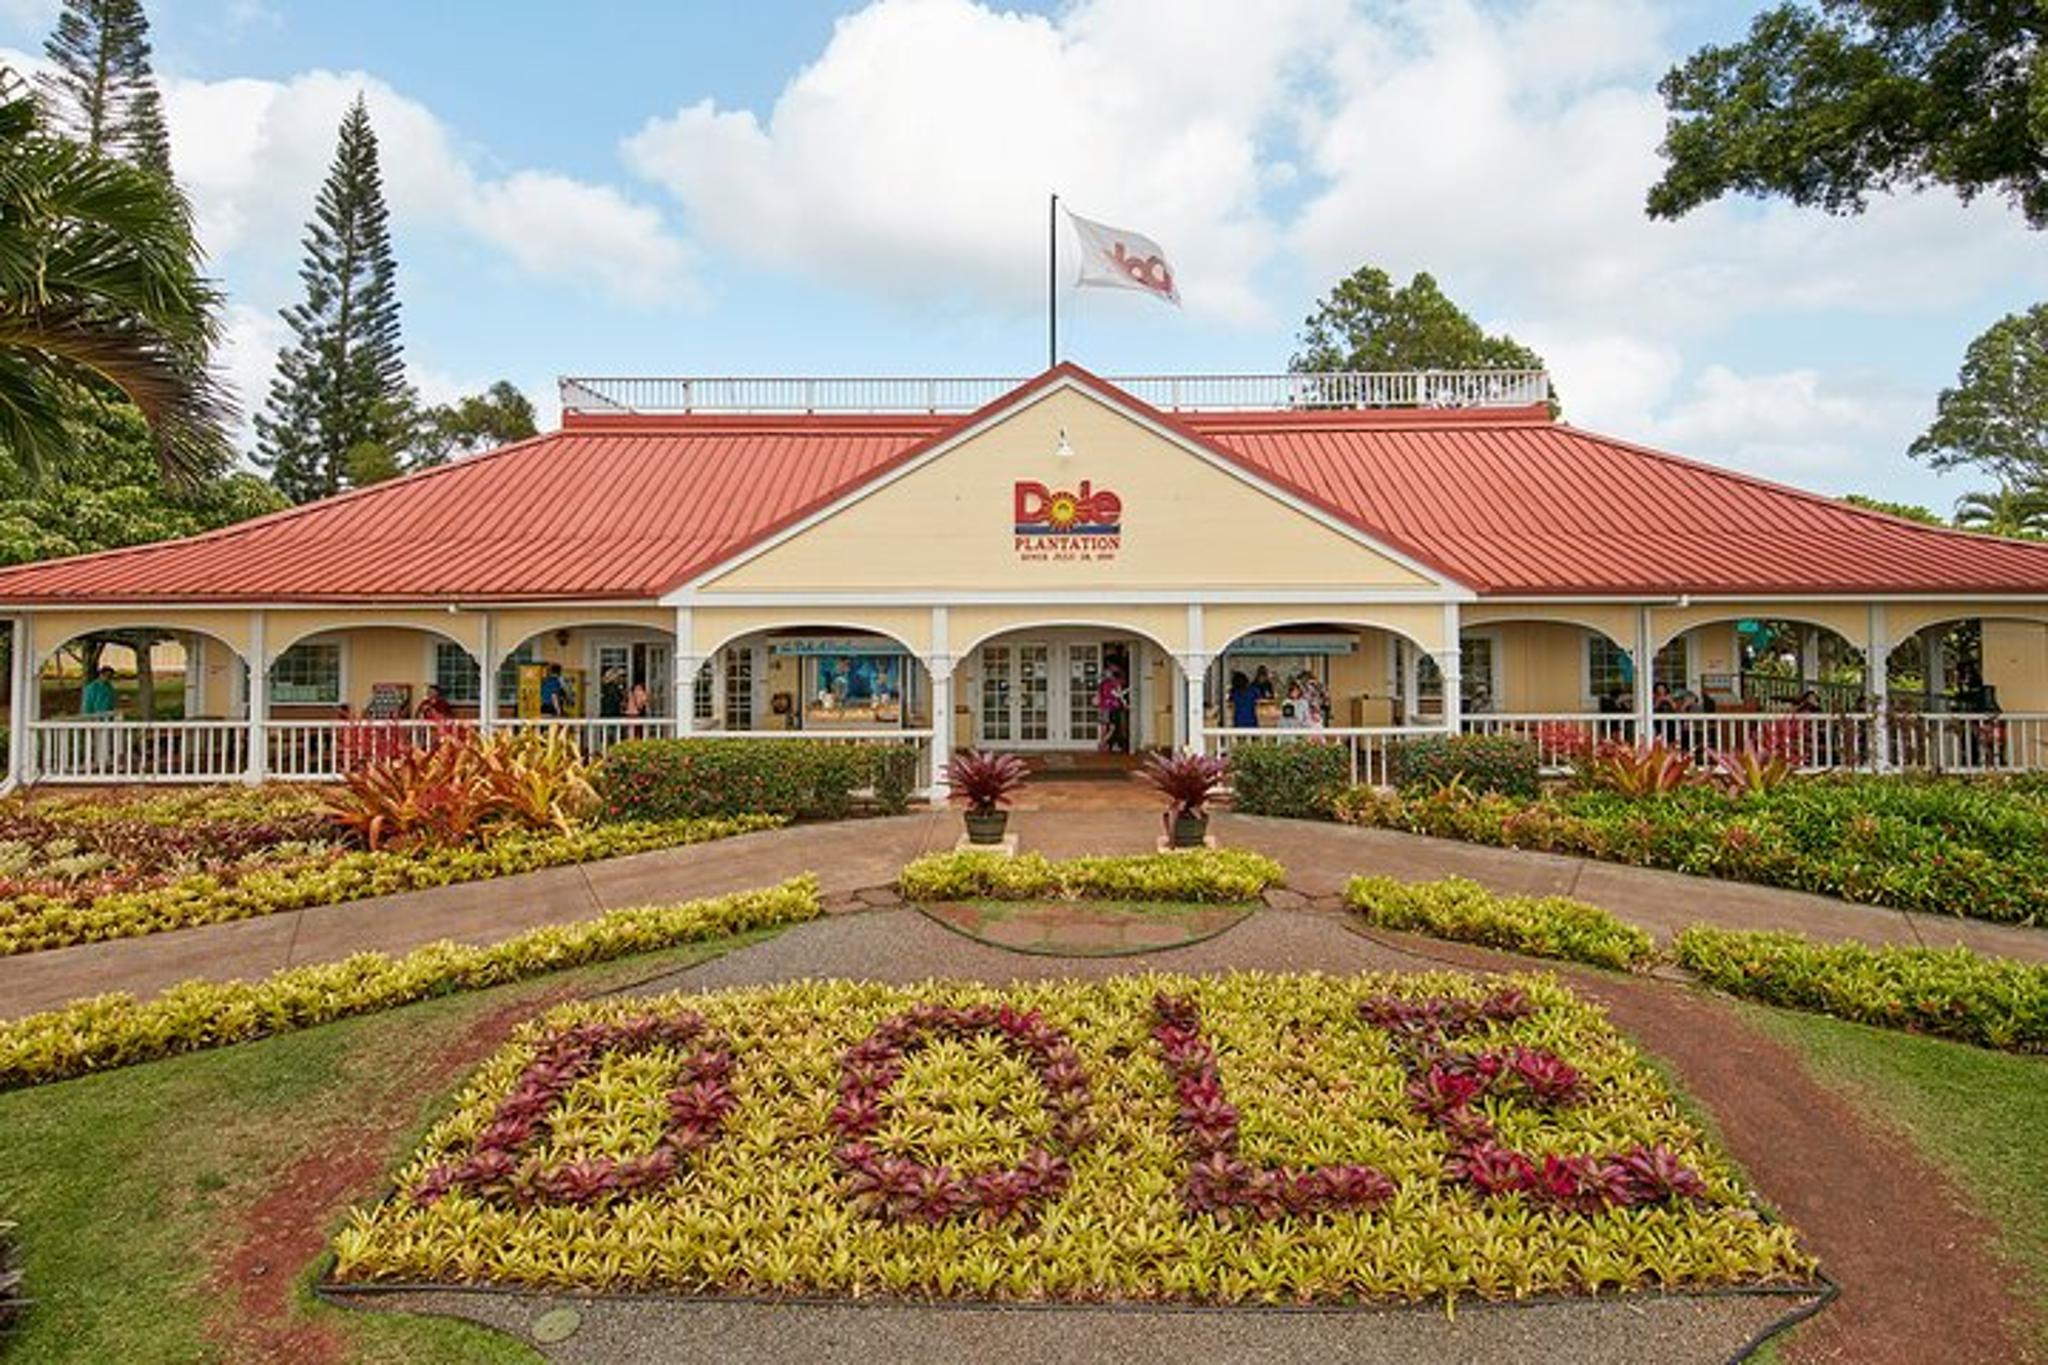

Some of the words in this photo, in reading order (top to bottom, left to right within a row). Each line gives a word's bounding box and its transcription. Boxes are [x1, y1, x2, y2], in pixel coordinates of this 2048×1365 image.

[1015, 480, 1122, 533] Dole
[1014, 537, 1121, 551] PLANTATION
[410, 990, 1707, 1227] DOLE
